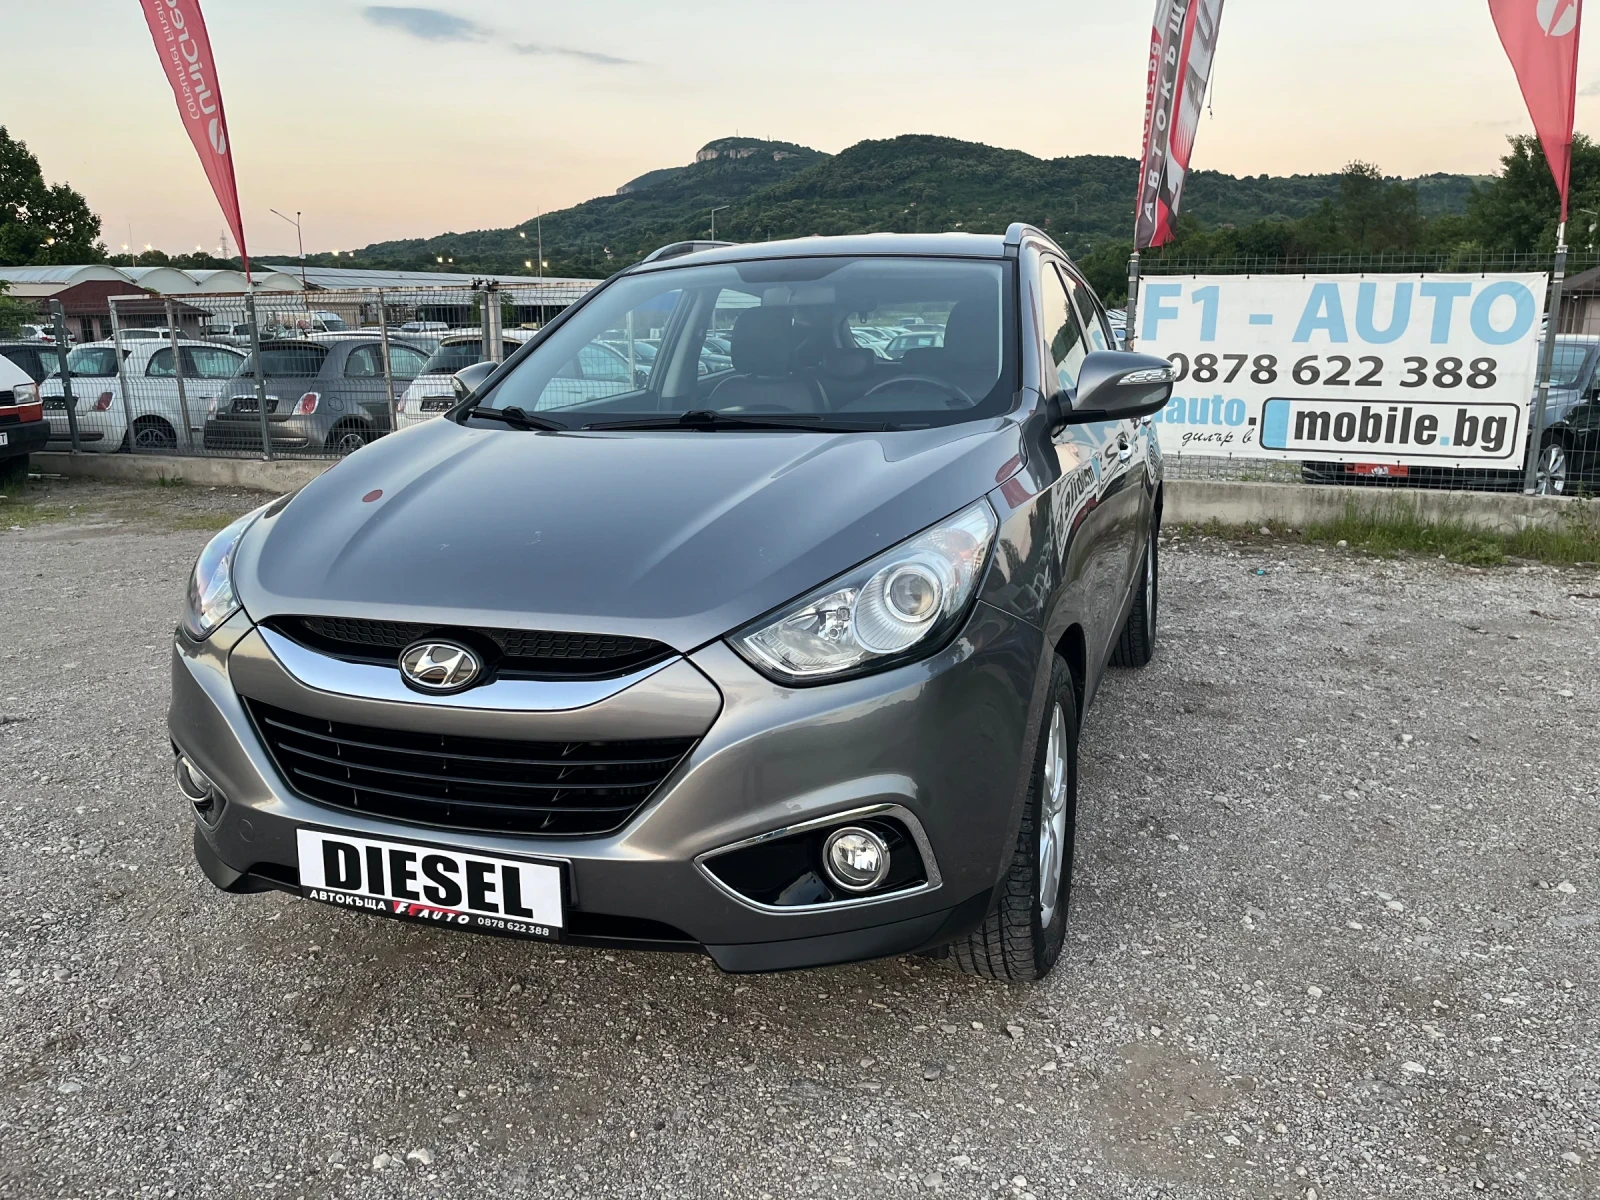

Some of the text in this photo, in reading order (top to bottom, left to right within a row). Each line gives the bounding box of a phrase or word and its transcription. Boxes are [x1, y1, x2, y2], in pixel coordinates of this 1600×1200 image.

[1141, 283, 1220, 342] F1
[1292, 280, 1536, 345] AUTO
[1166, 353, 1497, 389] 0878 622 388
[1294, 406, 1508, 452] mobile.bg
[322, 839, 534, 919] DIESEL
[309, 889, 387, 911] АВТОКЪЩА
[418, 909, 470, 925] AUTO
[477, 917, 550, 936] 0878 622 388
